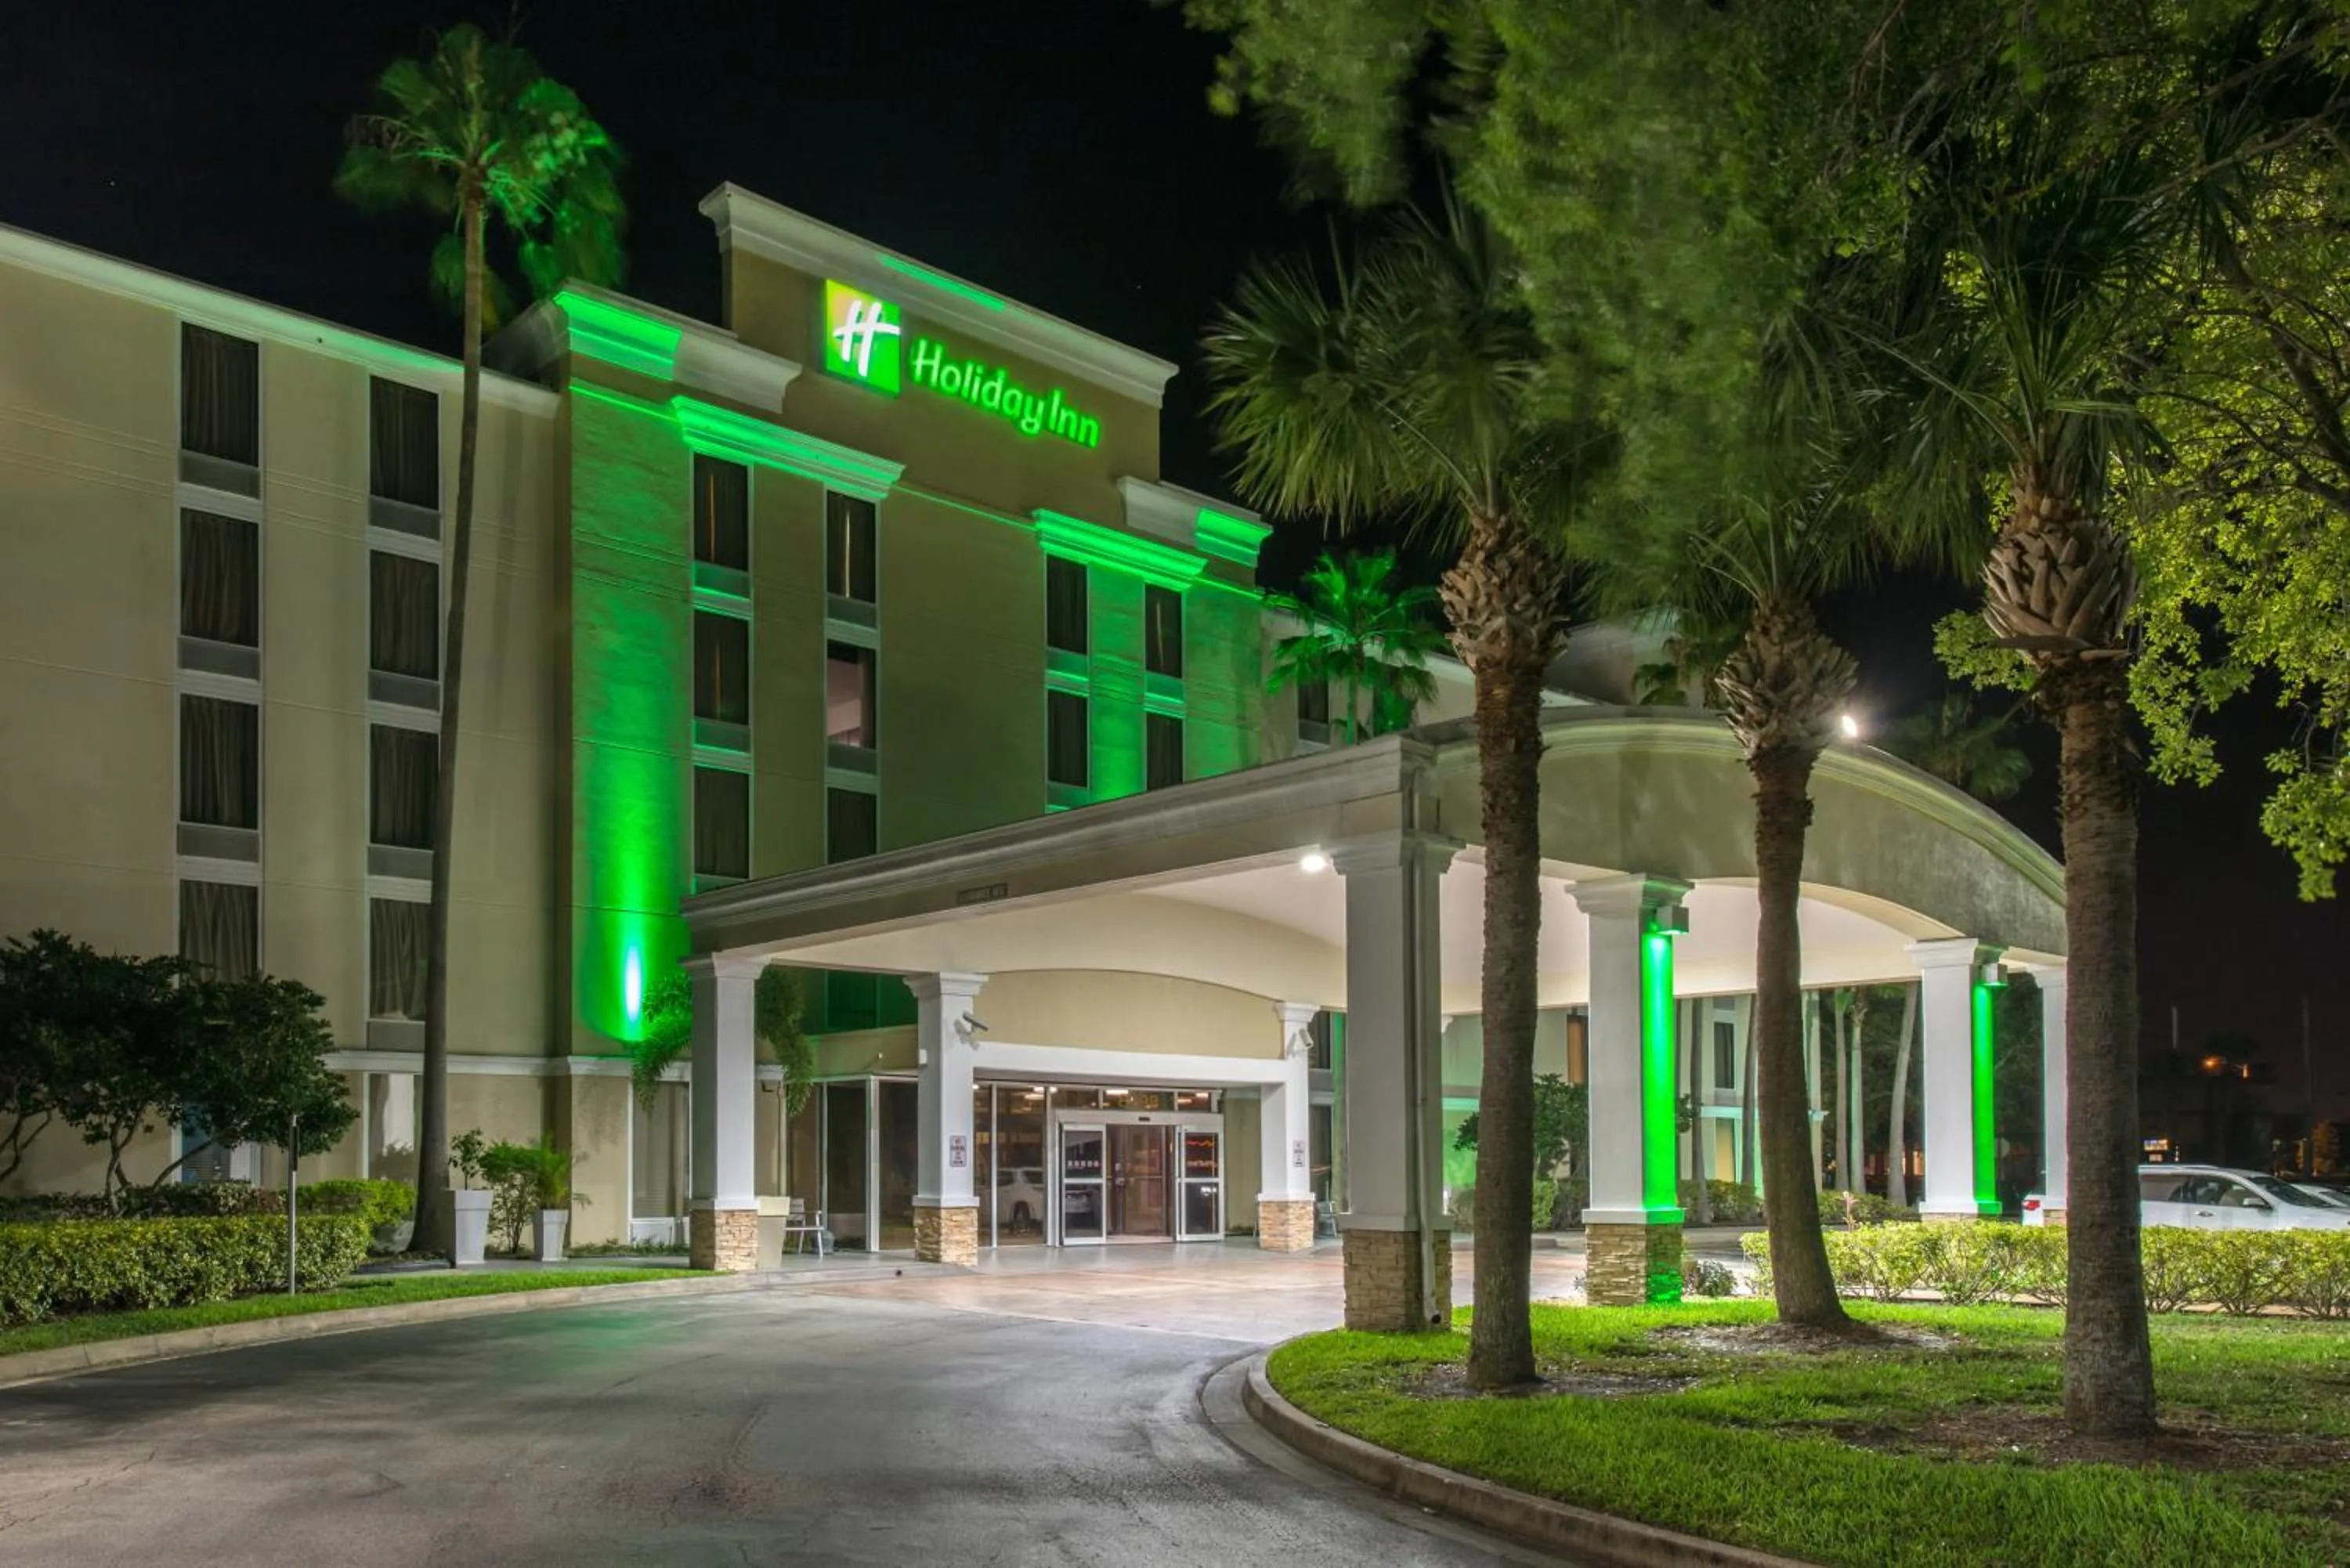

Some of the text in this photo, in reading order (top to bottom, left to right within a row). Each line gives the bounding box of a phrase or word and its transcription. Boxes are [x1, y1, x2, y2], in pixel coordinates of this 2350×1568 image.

[833, 299, 902, 377] H
[912, 338, 1098, 448] Holiday Inn
